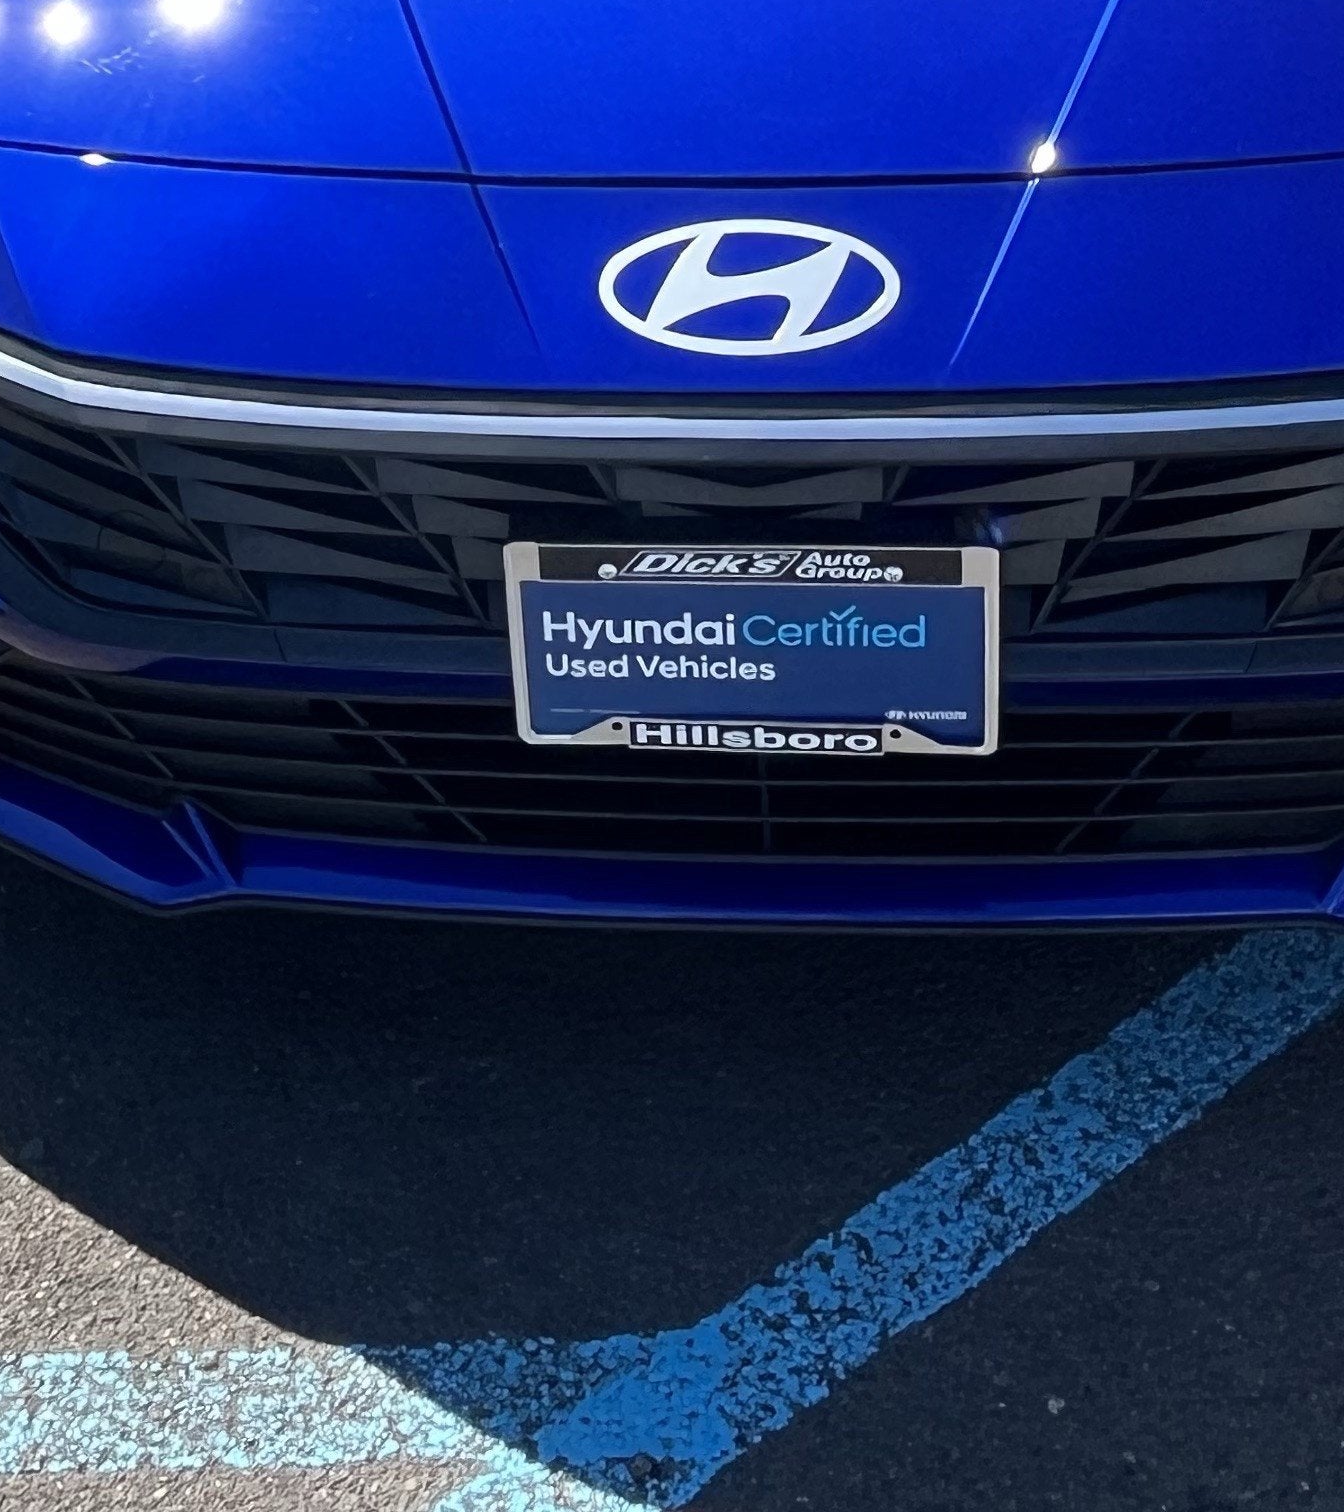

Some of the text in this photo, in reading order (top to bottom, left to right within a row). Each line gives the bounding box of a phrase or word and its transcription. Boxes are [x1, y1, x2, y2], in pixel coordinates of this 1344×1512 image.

[633, 552, 781, 575] Dick's
[804, 551, 871, 567] Auto
[795, 565, 885, 582] Group
[543, 605, 926, 650] Hyundai Certified
[545, 653, 776, 681] Used Vehicles
[636, 723, 878, 752] Hillsboro
